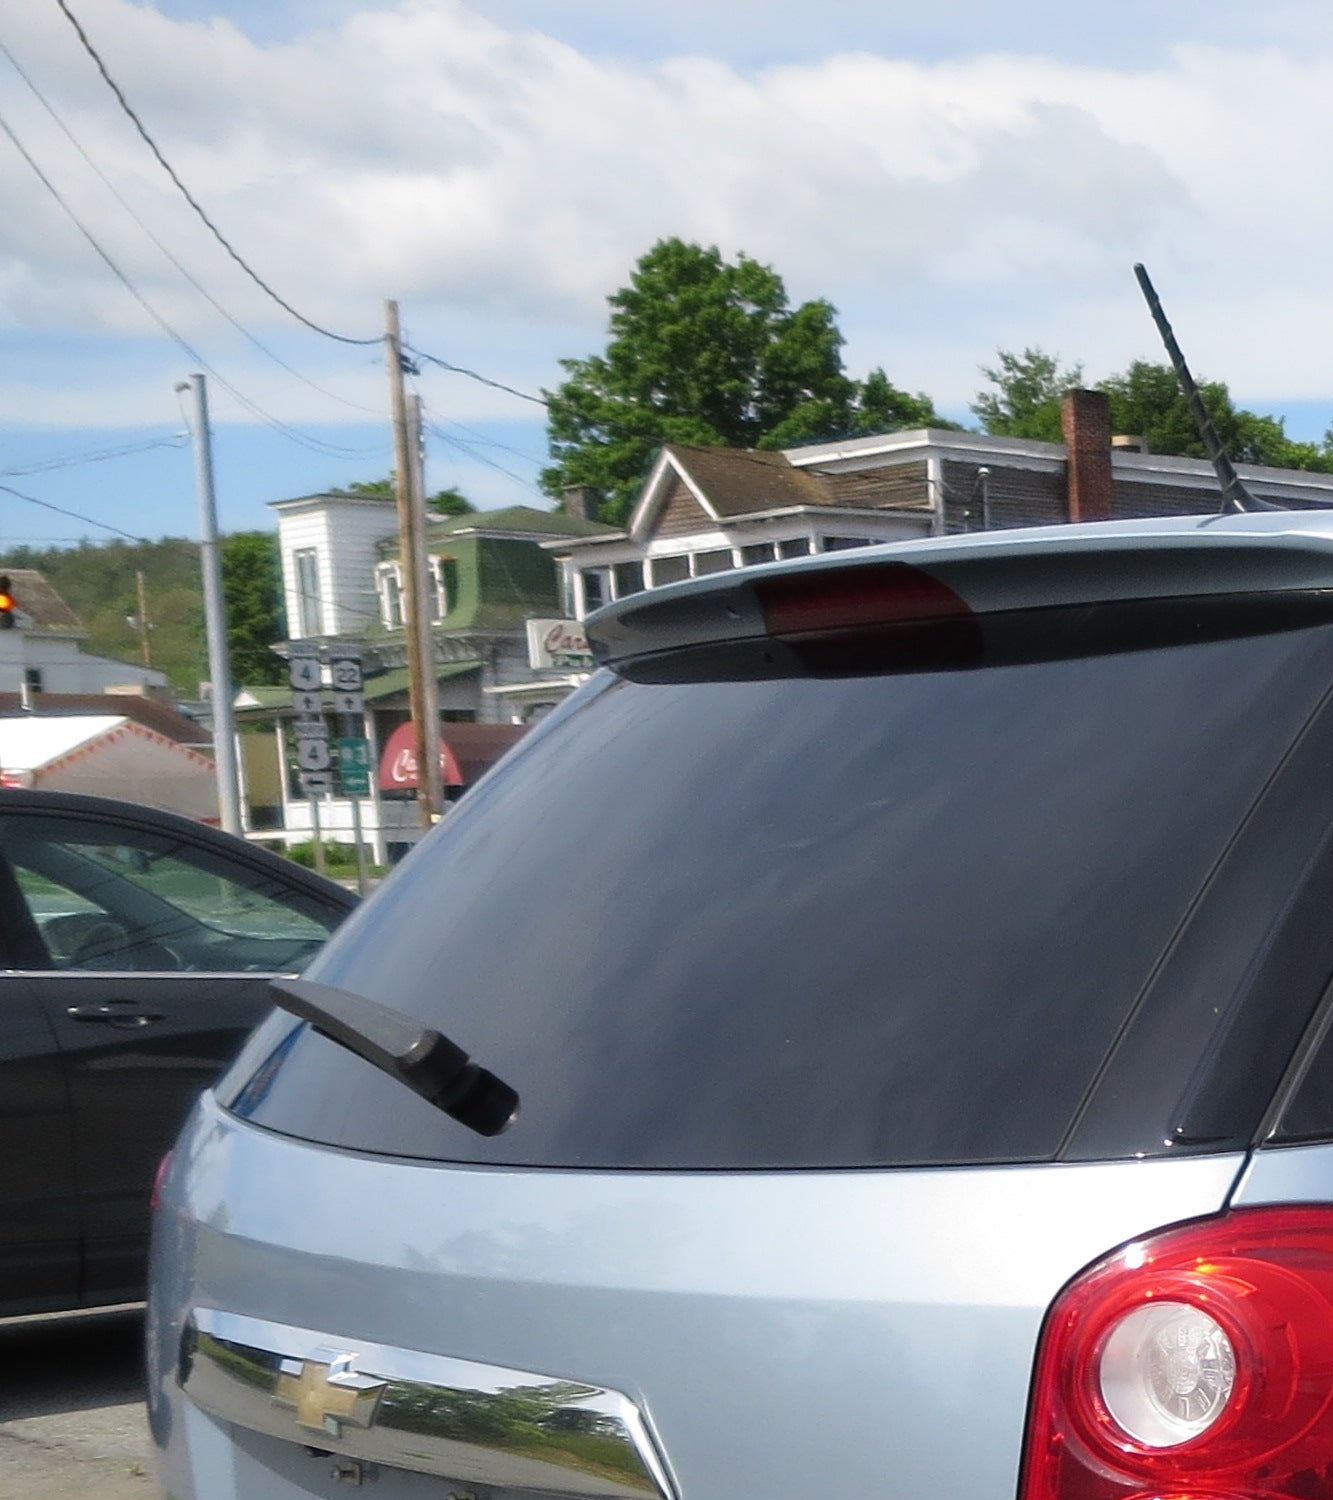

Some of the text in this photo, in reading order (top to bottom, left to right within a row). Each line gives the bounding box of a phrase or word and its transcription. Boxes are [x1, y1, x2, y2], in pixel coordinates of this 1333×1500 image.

[301, 664, 312, 682] 4
[336, 667, 358, 684] 22
[307, 746, 319, 763] 4
